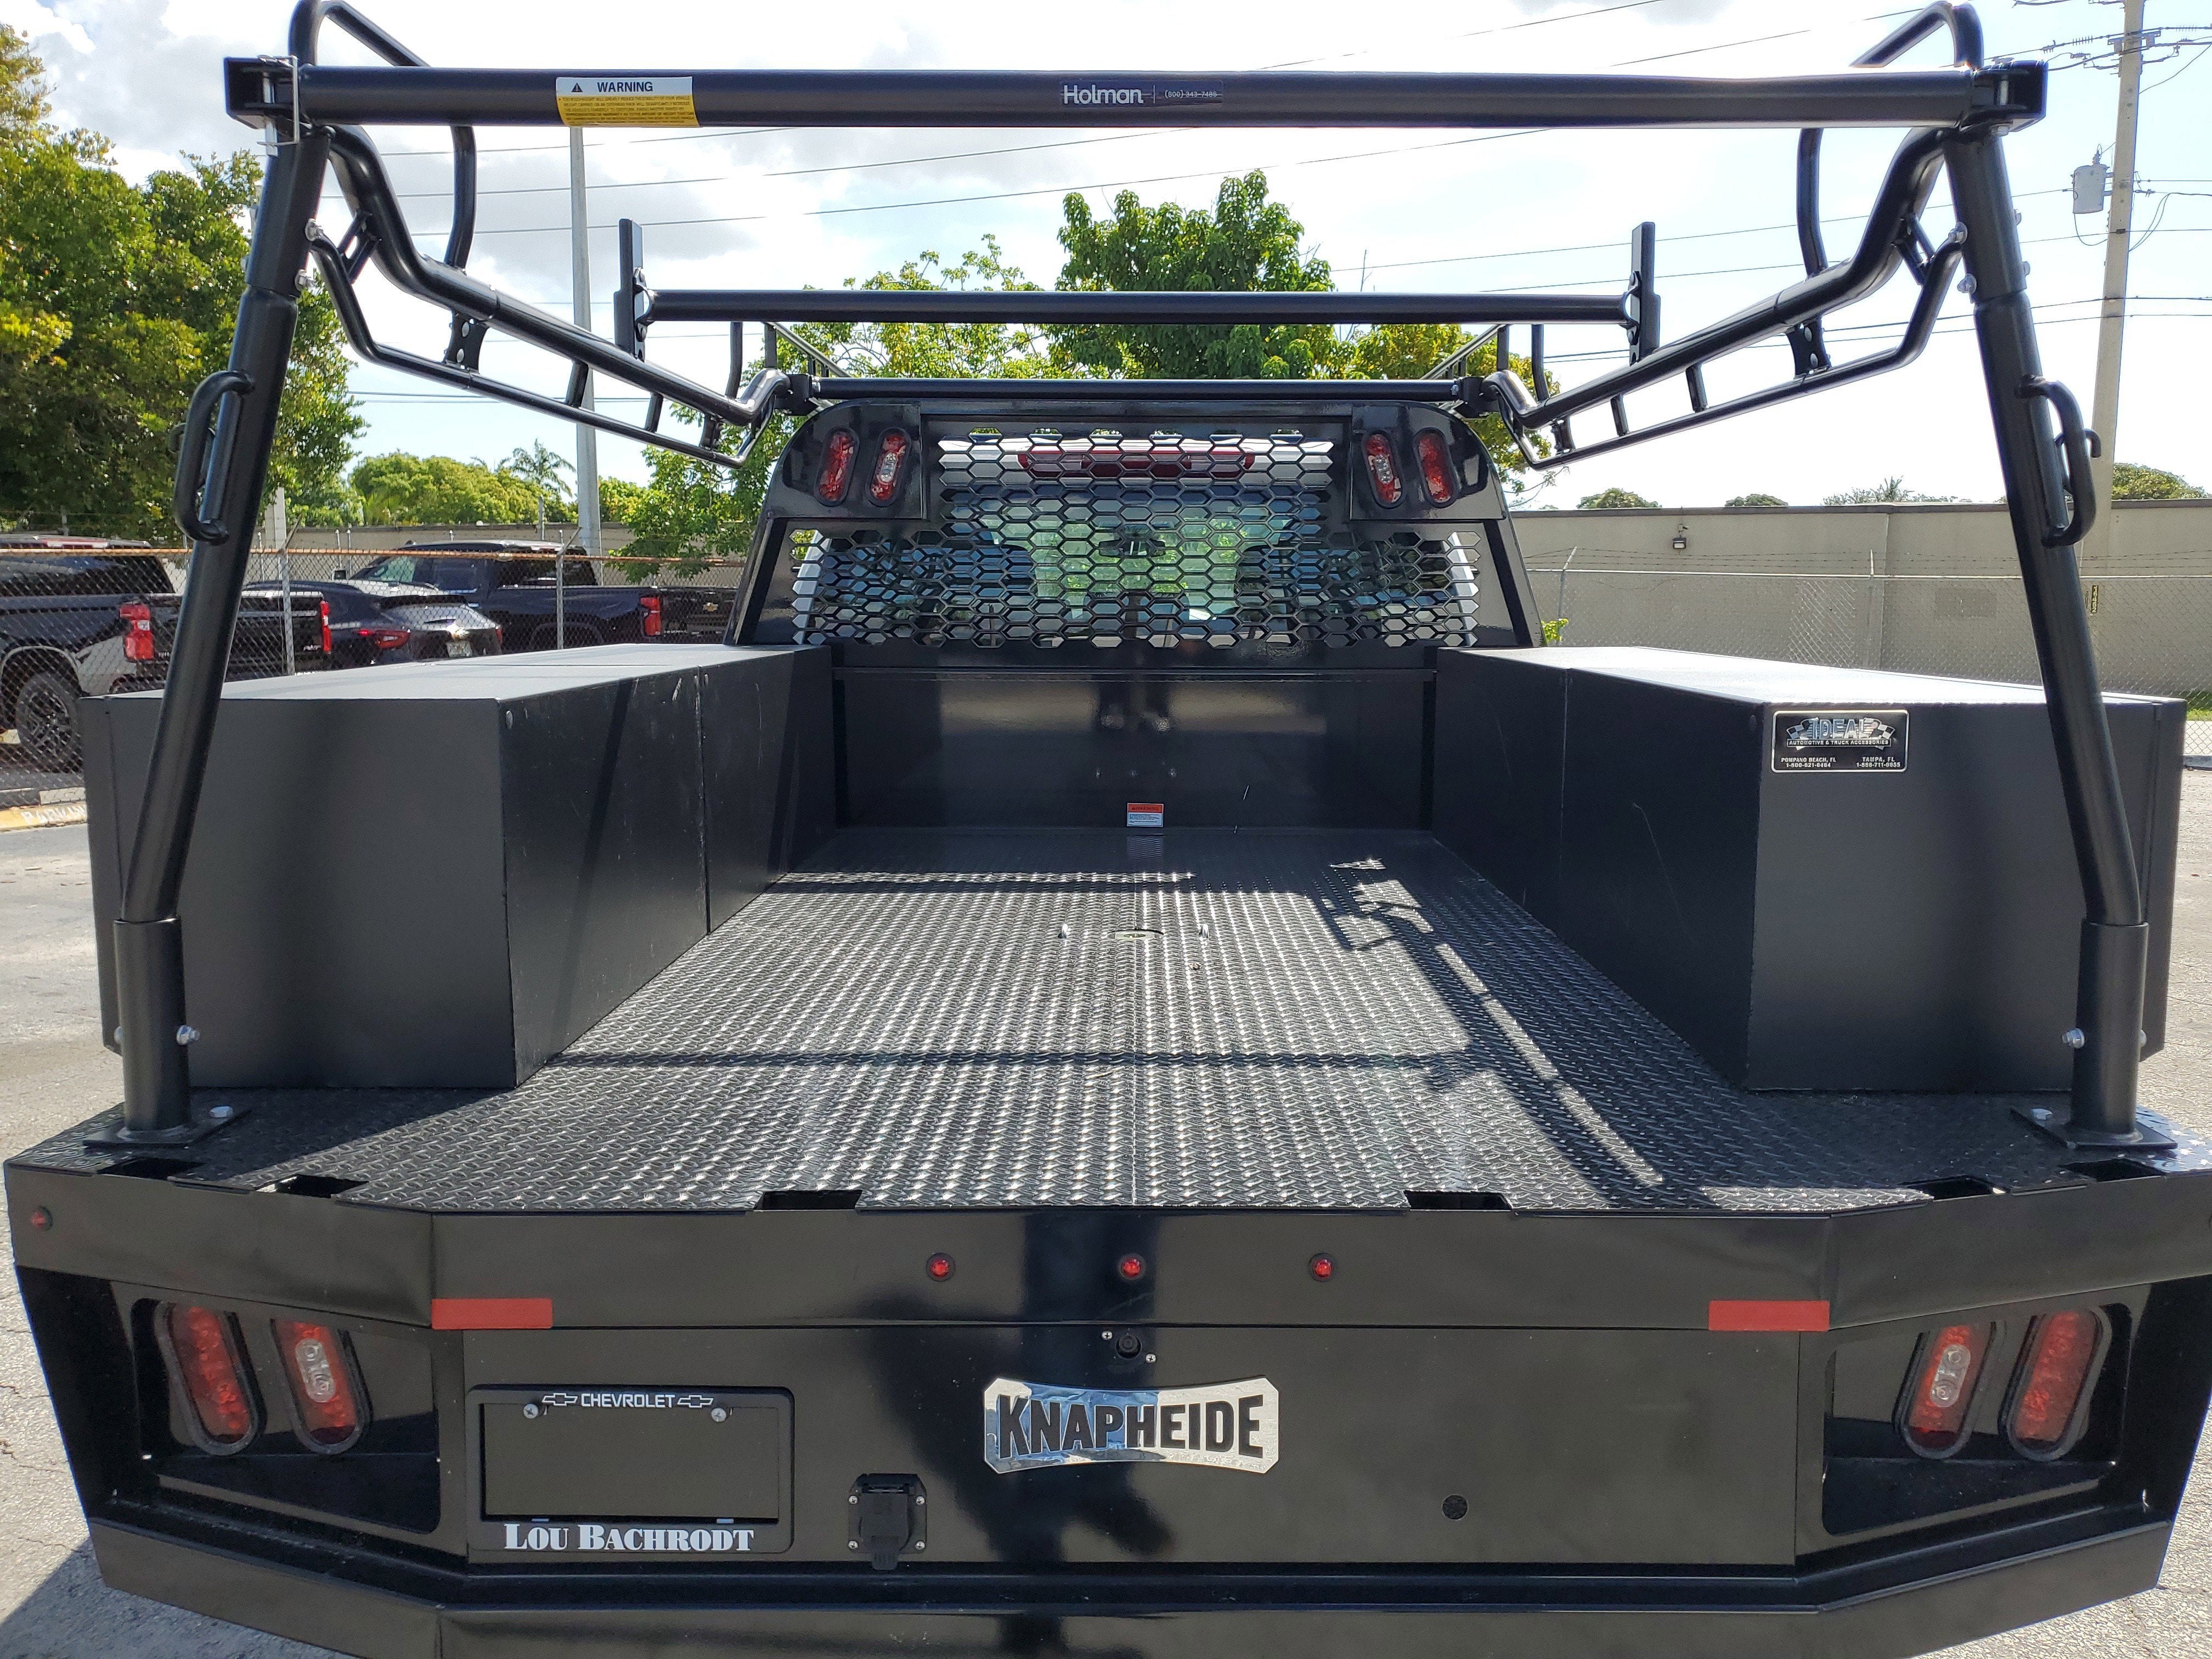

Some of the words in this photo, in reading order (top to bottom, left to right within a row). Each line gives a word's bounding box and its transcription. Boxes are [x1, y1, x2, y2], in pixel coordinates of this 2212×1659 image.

[597, 81, 653, 92] WARNING
[1064, 84, 1144, 104] Holman
[1165, 89, 1184, 99] (800)
[1812, 719, 1869, 739] IDEAL
[580, 1394, 676, 1408] CHEVROLET
[998, 1393, 1264, 1459] KNAPHEIDE
[504, 1524, 568, 1550] LOU
[578, 1524, 754, 1551] BACHRODT
